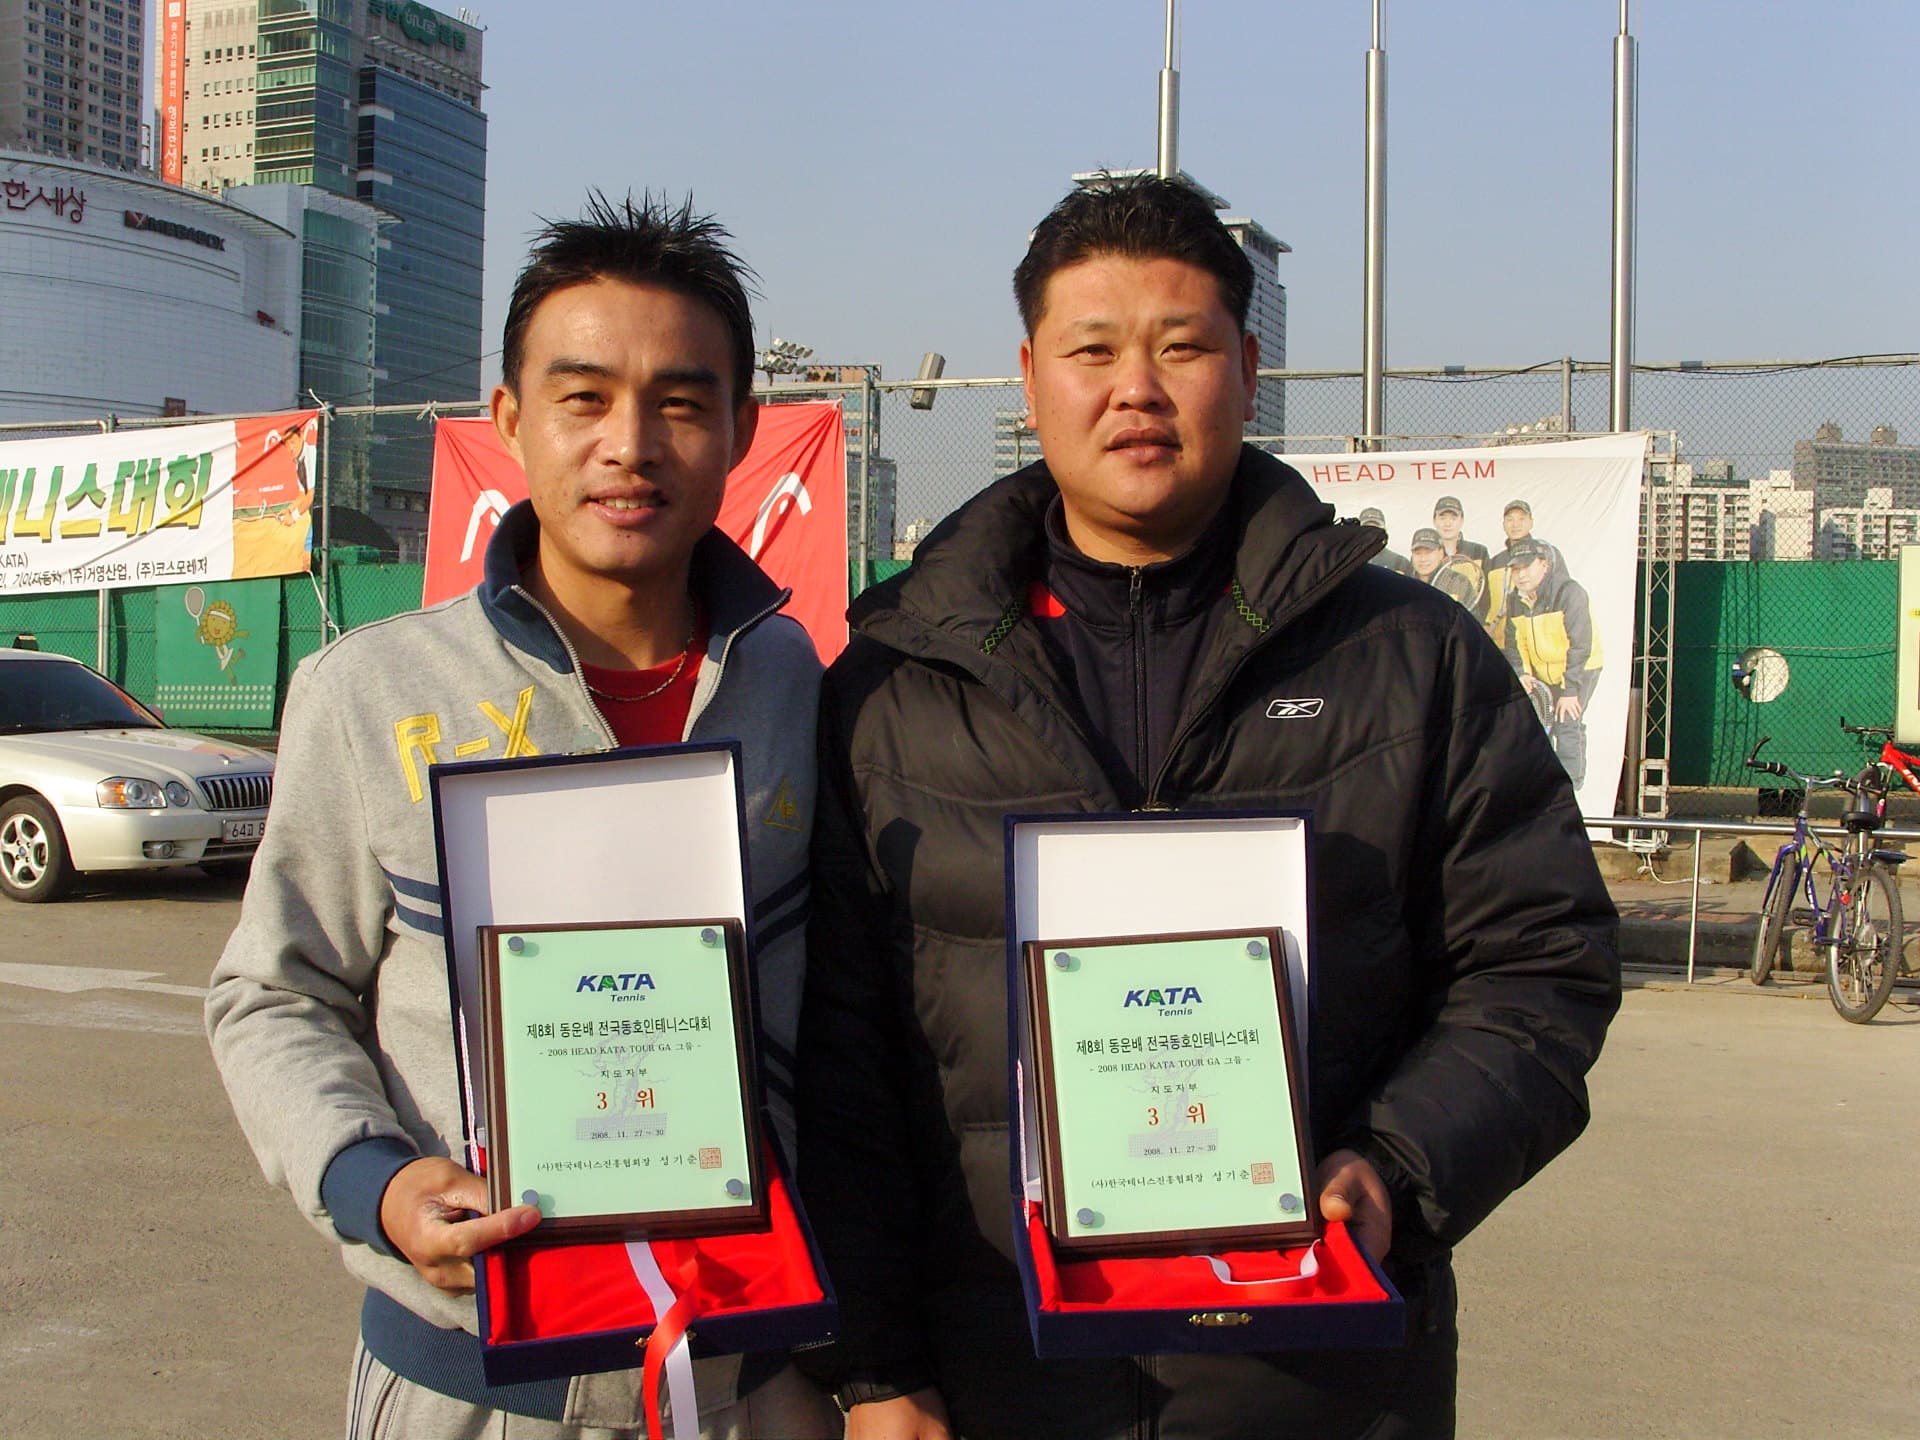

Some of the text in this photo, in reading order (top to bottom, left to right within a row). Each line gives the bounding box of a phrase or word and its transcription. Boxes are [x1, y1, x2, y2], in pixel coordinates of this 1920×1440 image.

[0, 178, 87, 223] 한세상
[1312, 459, 1496, 484] HEAD TEAM
[135, 555, 208, 581] (주)코스모레저
[575, 973, 656, 993] KATA
[609, 993, 646, 1003] Tennis
[1123, 986, 1203, 1008] KATA
[1157, 1007, 1193, 1017] Tennis
[527, 1016, 712, 1039] 제8회 동운배 전국동호인테니스대회
[547, 1049, 568, 1057] 2008
[571, 1047, 597, 1056] HEAD
[600, 1046, 627, 1055] KATA
[629, 1044, 656, 1053] TOUR
[658, 1043, 672, 1051] GA
[1076, 1028, 1260, 1056] 제8회 동운배 전국동호인테니스대회
[1098, 1064, 1118, 1073] 2008
[1121, 1063, 1146, 1072] HEAD
[1149, 1060, 1175, 1070] KATA
[1179, 1058, 1205, 1068] TOUR
[1207, 1057, 1221, 1066] GA
[596, 1087, 654, 1110] 3 위
[1147, 1102, 1205, 1126] 3 위
